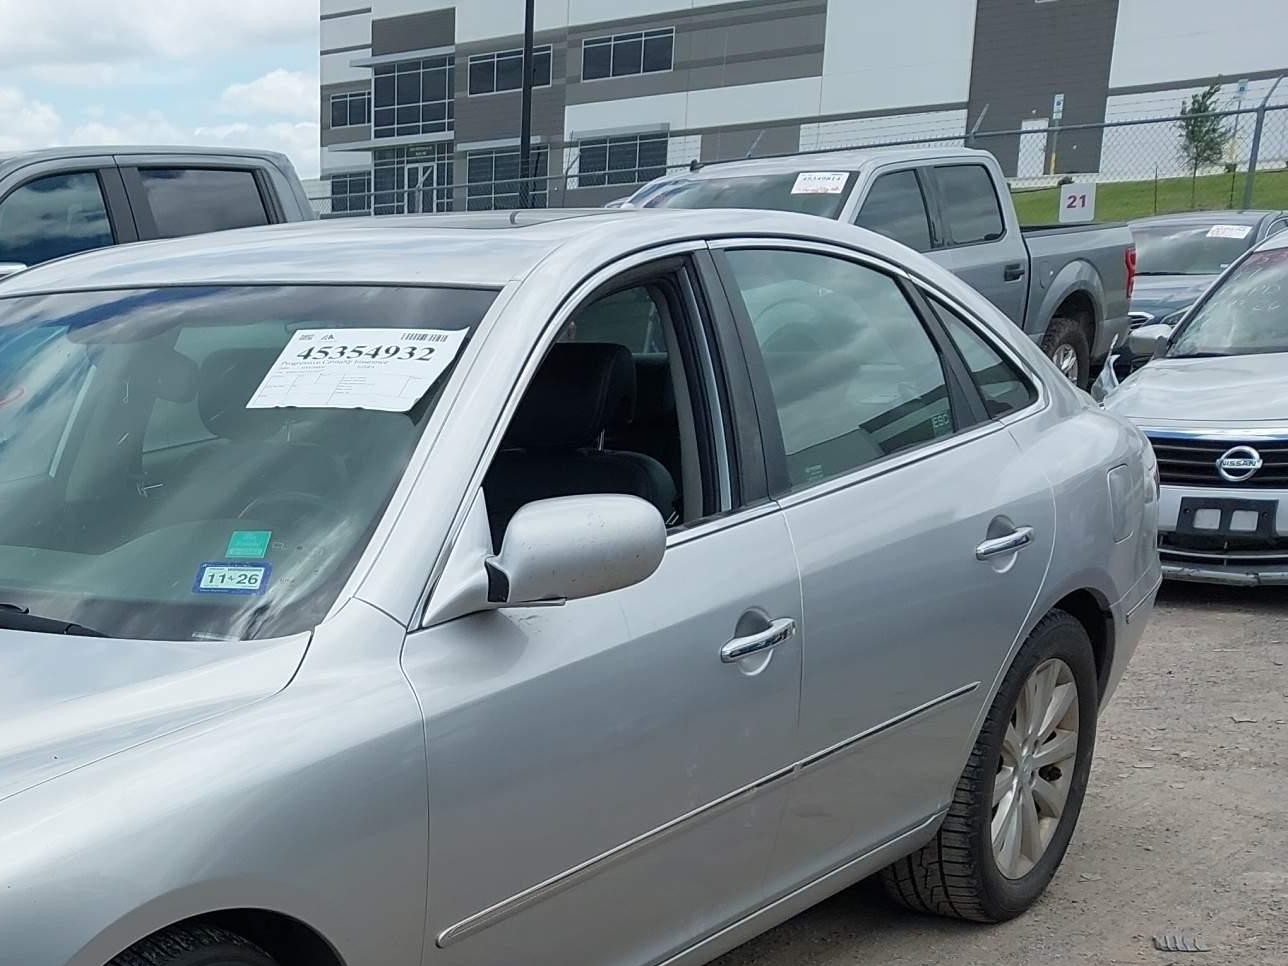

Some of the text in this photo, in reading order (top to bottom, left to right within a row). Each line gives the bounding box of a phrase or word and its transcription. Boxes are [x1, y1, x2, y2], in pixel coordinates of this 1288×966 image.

[1066, 194, 1087, 209] 21
[296, 344, 436, 362] 45354932
[1220, 459, 1257, 467] NISSAN
